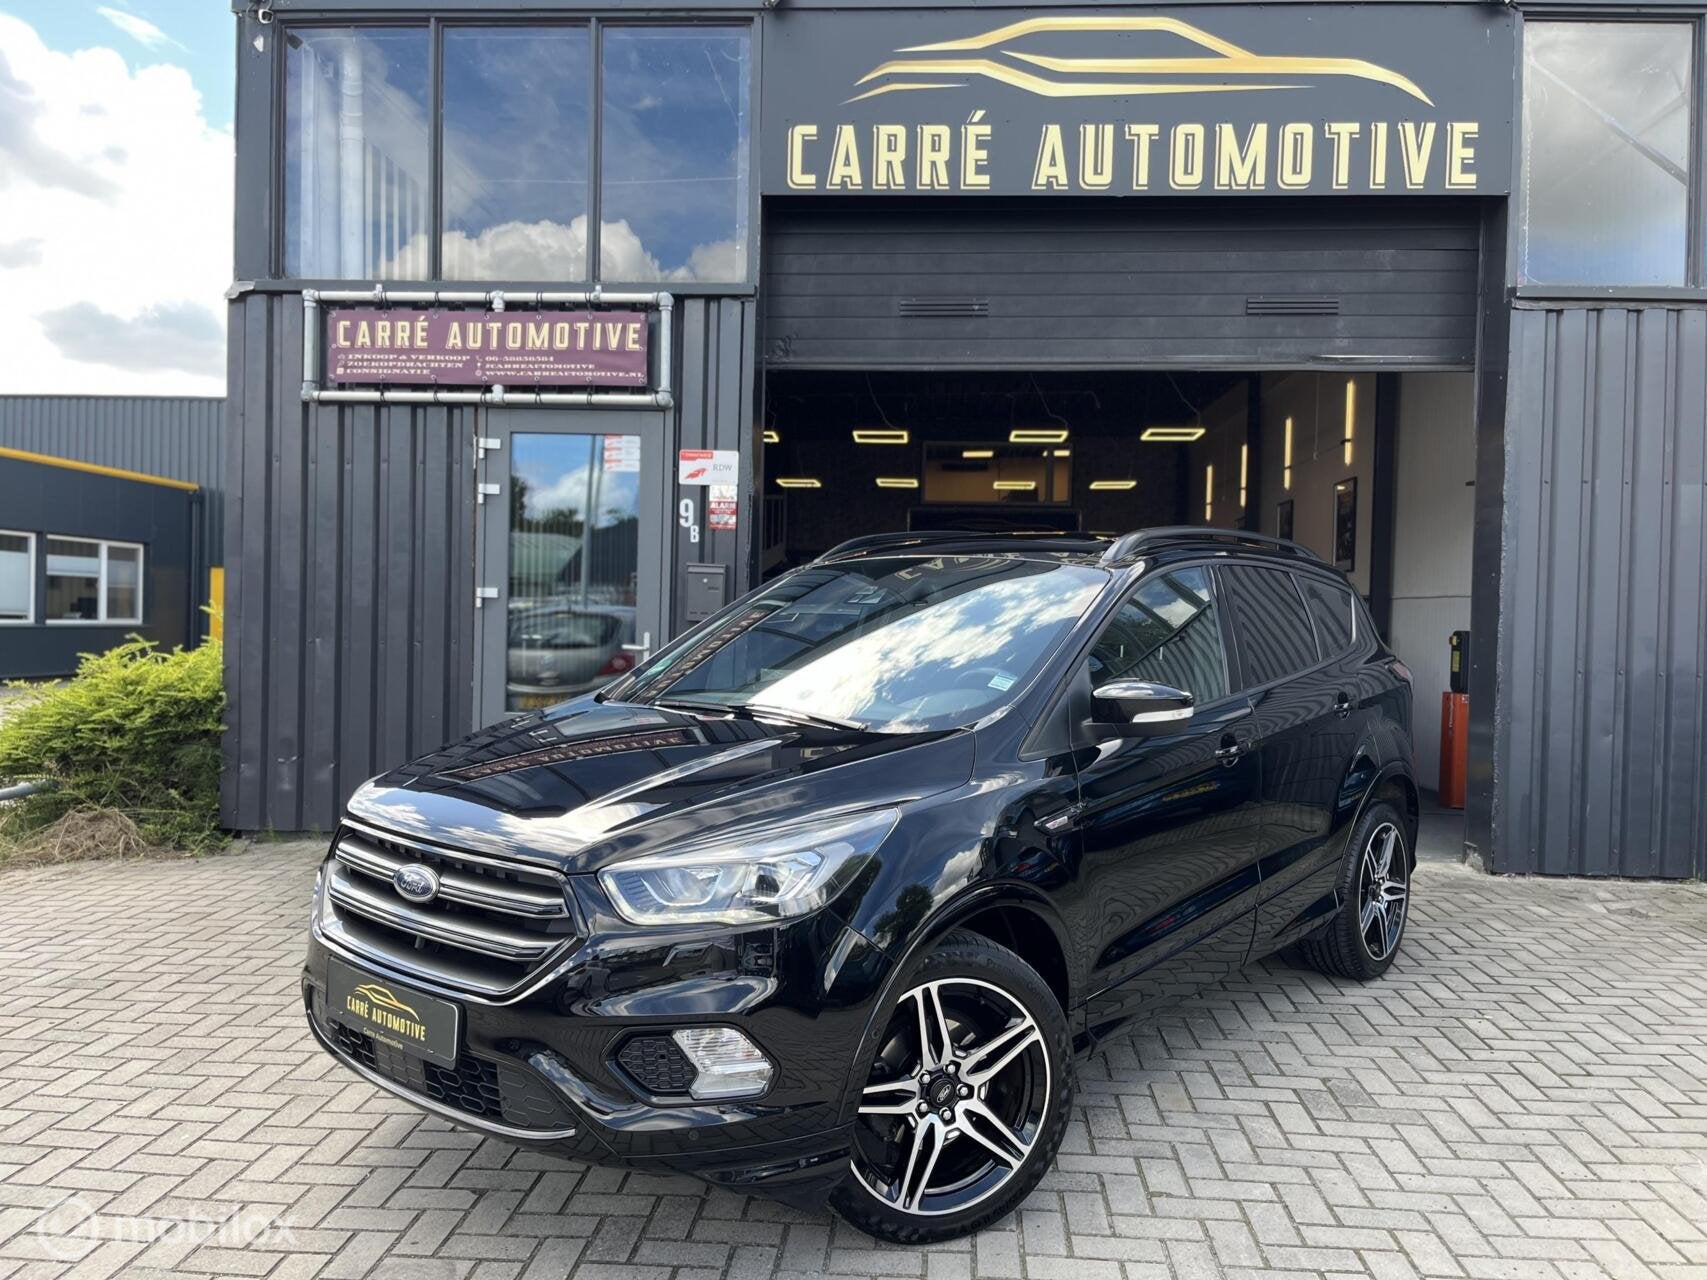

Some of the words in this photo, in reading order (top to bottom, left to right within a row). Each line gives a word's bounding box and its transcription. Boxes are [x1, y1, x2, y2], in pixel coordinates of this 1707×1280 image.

[786, 110, 992, 191] CARRÉ
[1031, 121, 1480, 191] AUTOMOTIVE
[336, 316, 429, 349] CARRÉ
[446, 321, 642, 351] AUTOMOTIVE
[713, 464, 732, 472] RDW
[679, 499, 694, 527] 9
[690, 525, 699, 543] B
[347, 996, 369, 1018] CARRÉ
[372, 1007, 426, 1041] AUTOMOTIVE
